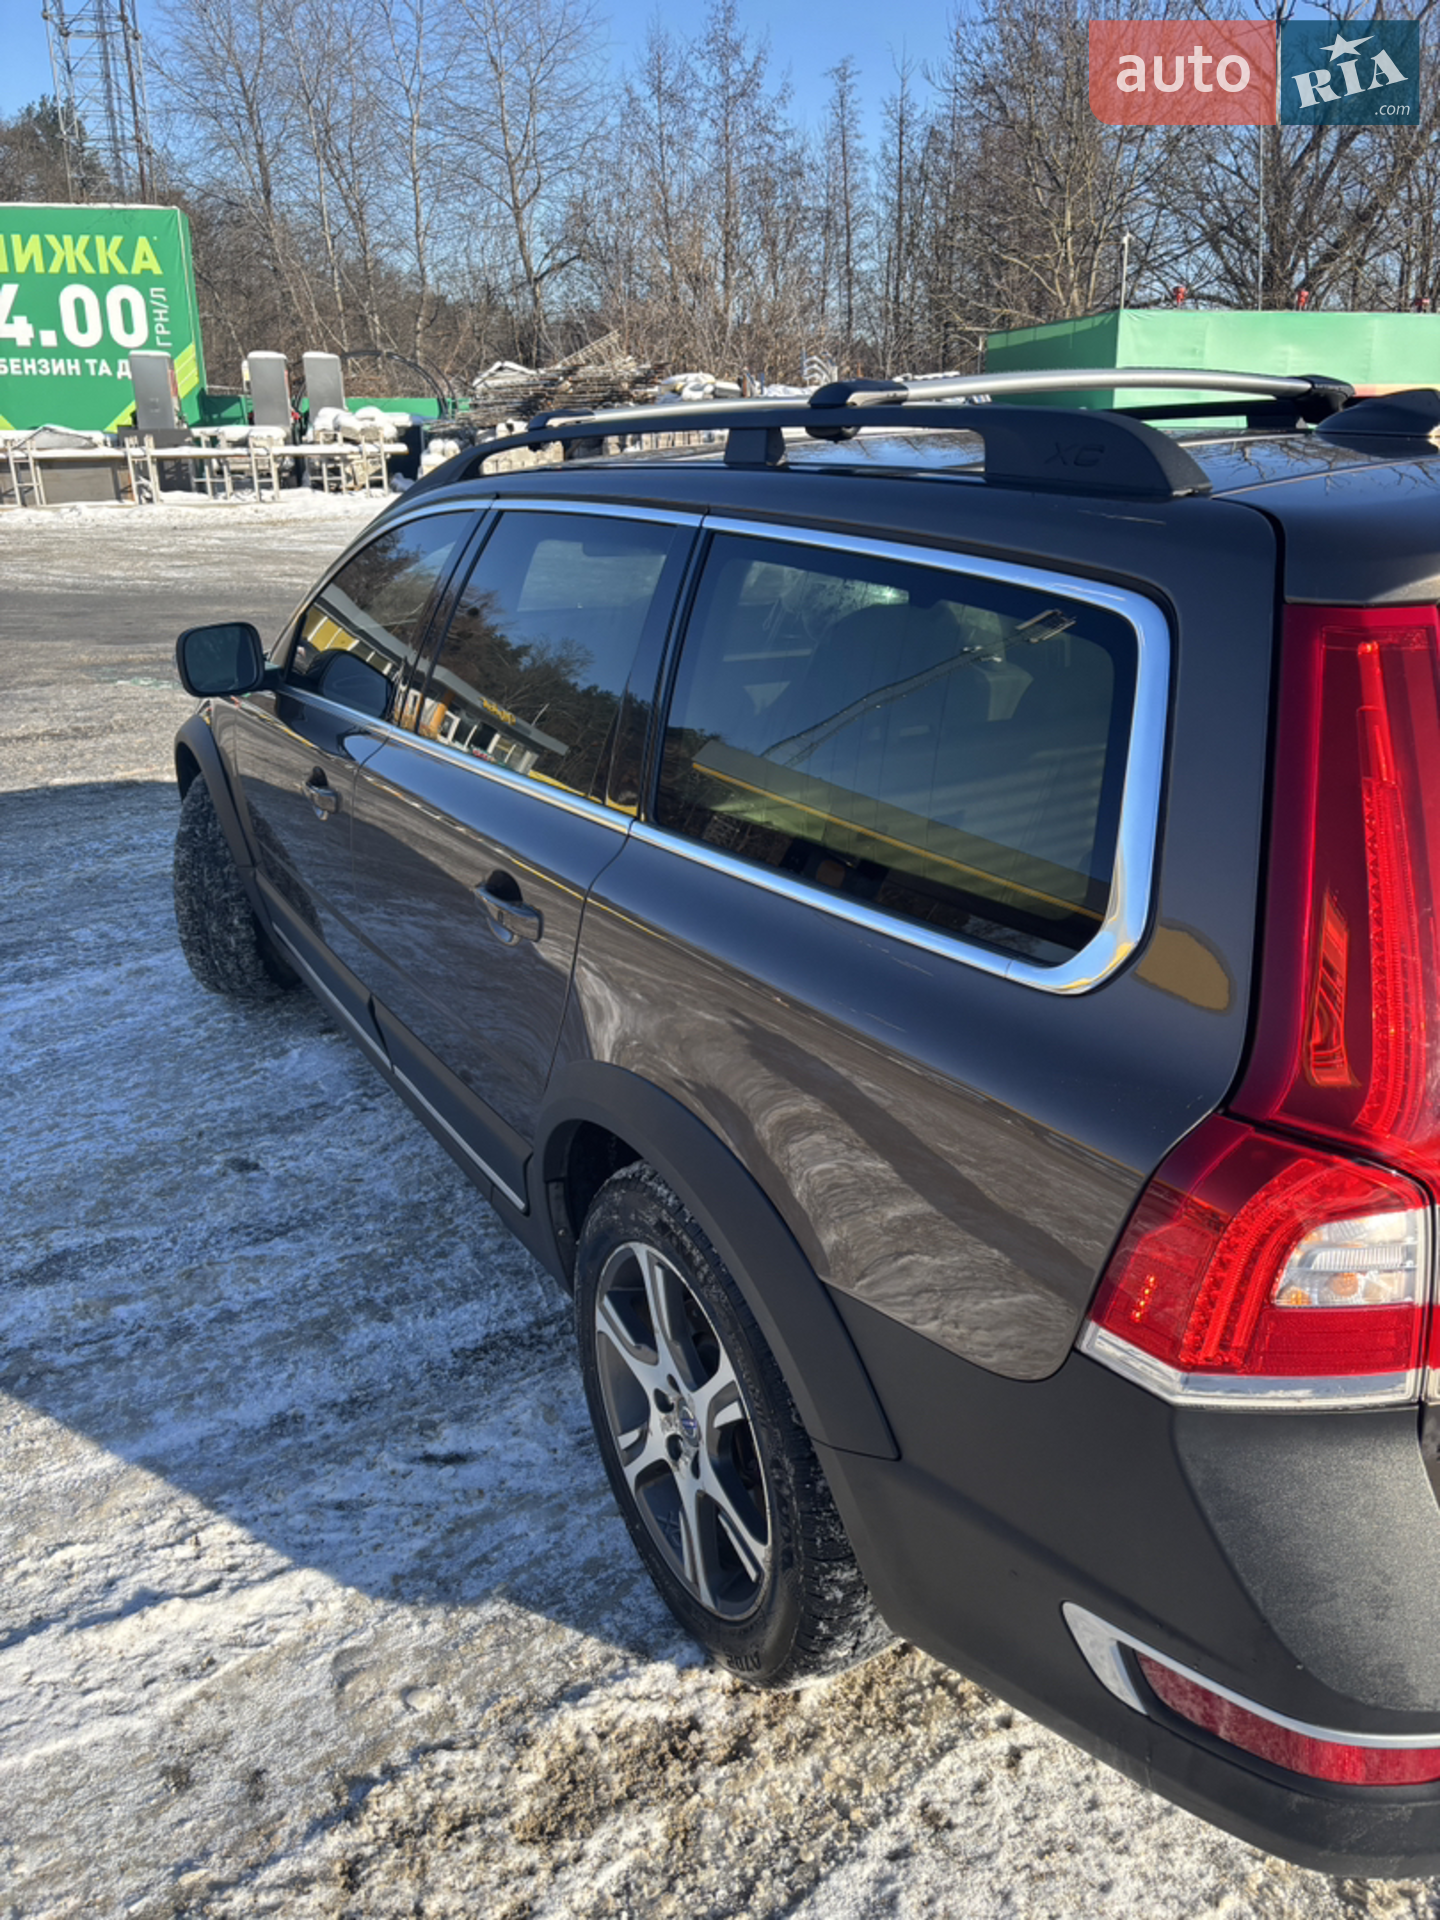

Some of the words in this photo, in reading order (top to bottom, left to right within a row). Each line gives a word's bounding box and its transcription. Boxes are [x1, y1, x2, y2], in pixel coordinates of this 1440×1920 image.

[150, 287, 173, 347] ГРН/Л
[0, 357, 81, 377] БЕНЗИН
[85, 358, 113, 377] ТА
[117, 358, 132, 380] Д
